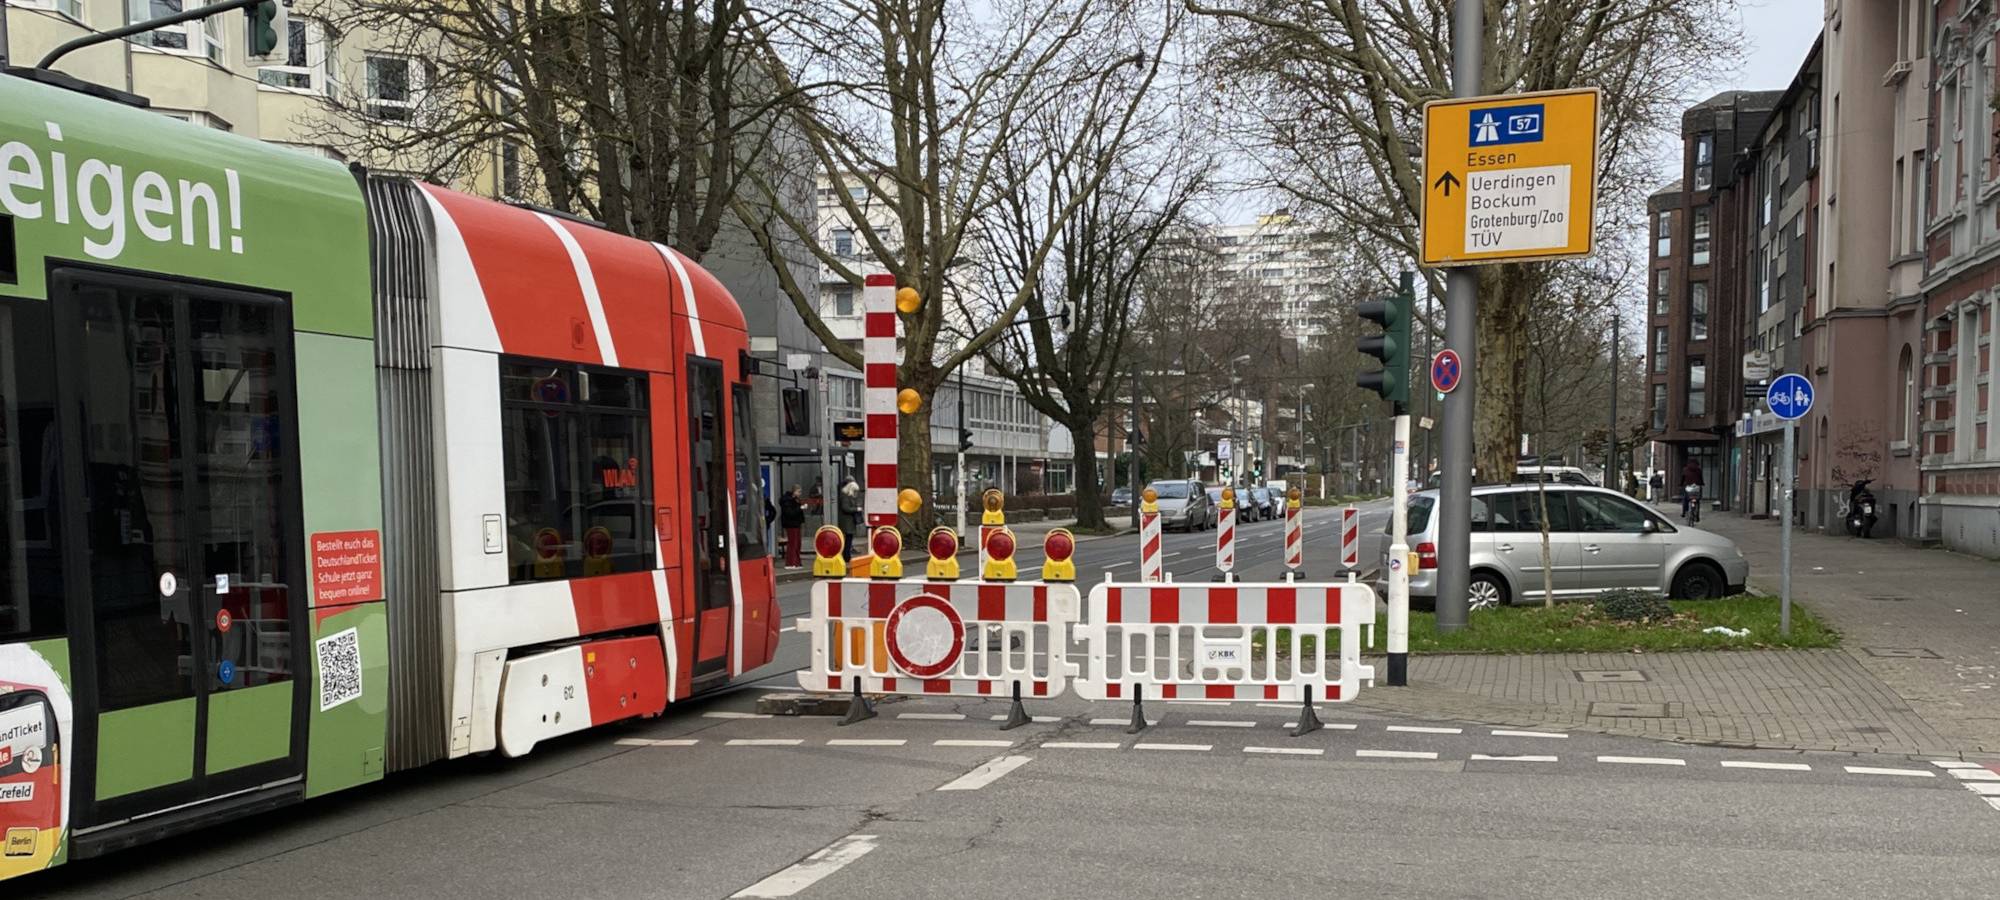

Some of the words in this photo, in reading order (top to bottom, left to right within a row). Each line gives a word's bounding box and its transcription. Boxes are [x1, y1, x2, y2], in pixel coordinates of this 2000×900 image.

[1516, 118, 1532, 131] 57
[1467, 152, 1517, 167] Essen
[1471, 173, 1556, 191] Uerdingen
[0, 121, 243, 260] eigen!
[1471, 194, 1536, 209] Bockum
[1470, 209, 1564, 229] Grotenburg/Zoo
[1471, 230, 1503, 247] TÜV
[603, 469, 637, 488] WLAN
[316, 539, 343, 552] Bestellt
[344, 538, 360, 550] euch
[361, 538, 374, 549] das
[317, 554, 377, 568] DeutschlandTicket
[318, 571, 340, 584] Schule
[341, 571, 356, 584] jetzt
[356, 571, 373, 583] ganz
[319, 587, 346, 600] bequem
[564, 685, 574, 700] 612
